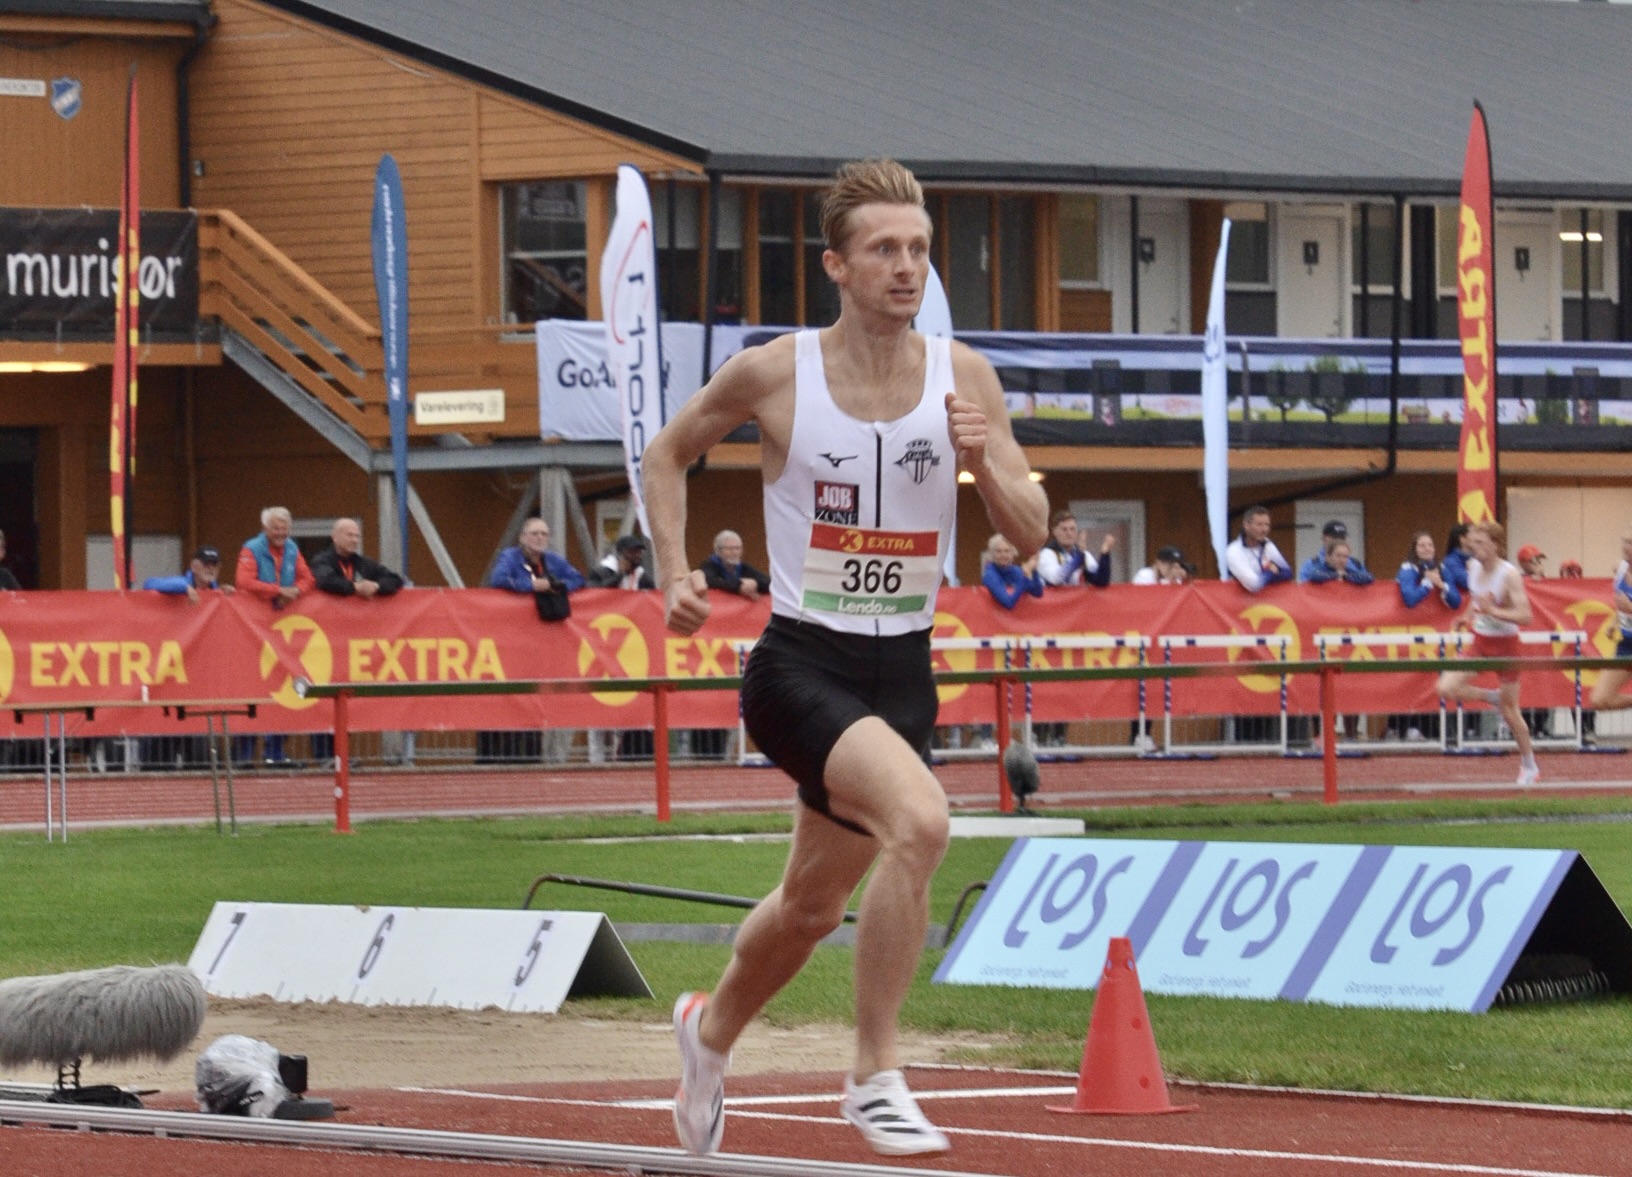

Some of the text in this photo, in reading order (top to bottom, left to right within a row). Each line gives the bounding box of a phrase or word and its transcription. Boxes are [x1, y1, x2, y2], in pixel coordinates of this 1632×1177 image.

[420, 401, 484, 415] Varelevering
[818, 485, 853, 509] JOB
[867, 536, 914, 550] EXTRA
[841, 559, 904, 594] 366
[29, 640, 189, 687] EXTRA
[348, 637, 506, 682] EXTRA
[1003, 853, 1136, 950] LOS
[1182, 857, 1319, 959] LOS
[1370, 863, 1514, 966] LOS
[208, 912, 553, 987] 7 6 5
